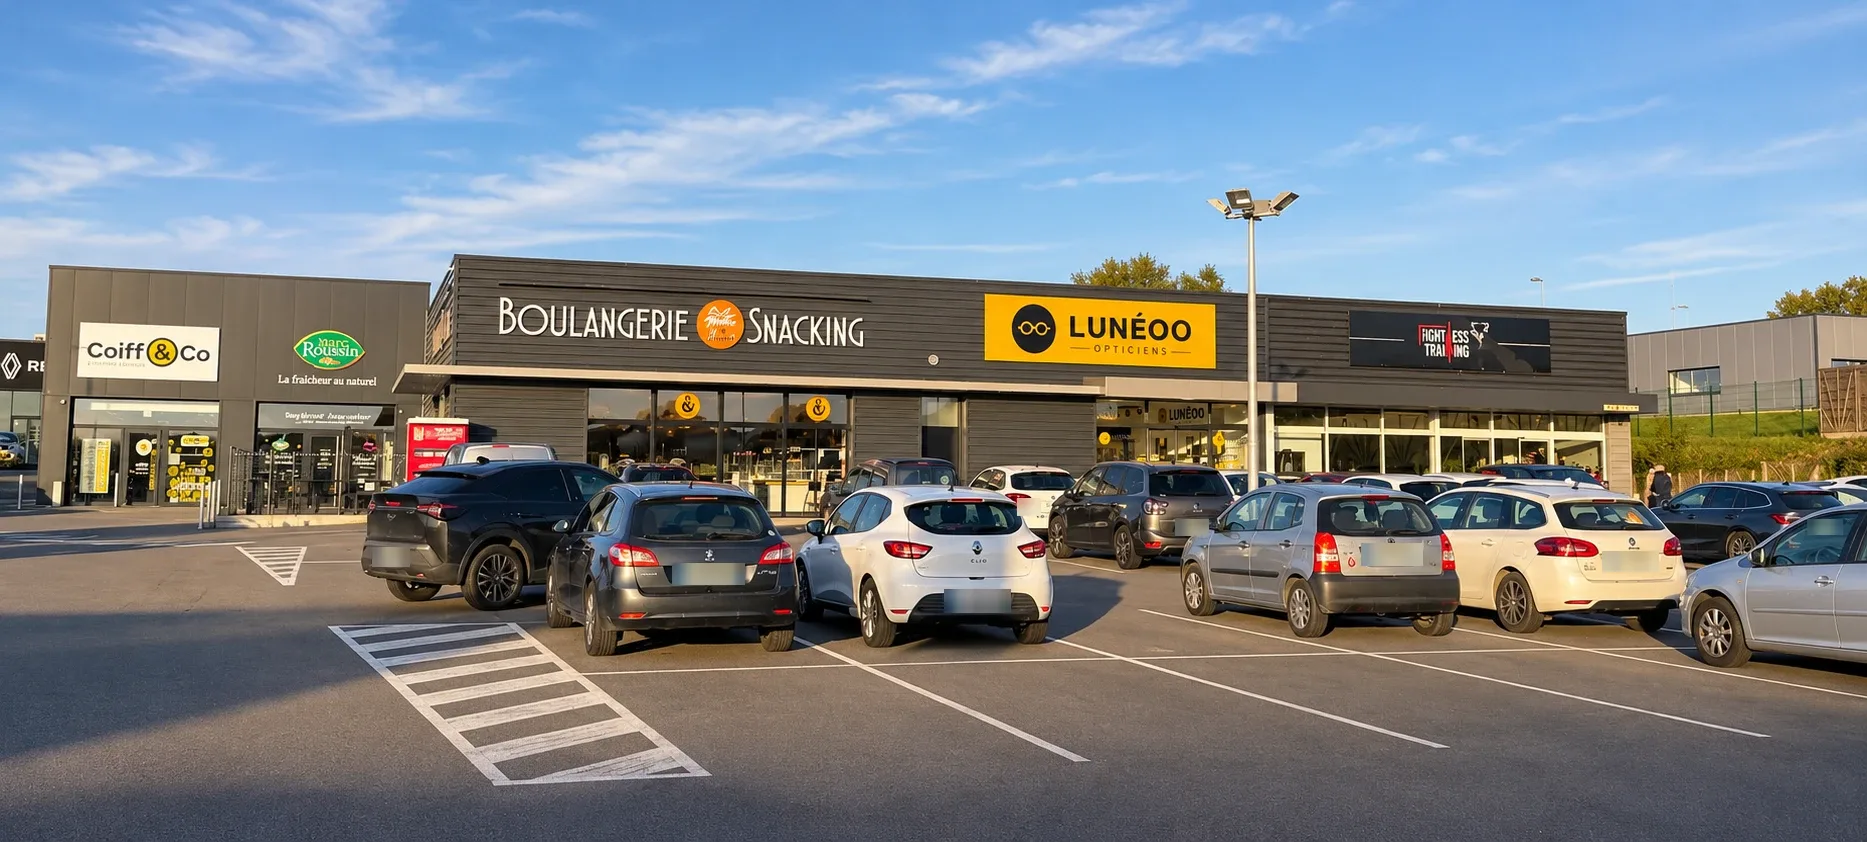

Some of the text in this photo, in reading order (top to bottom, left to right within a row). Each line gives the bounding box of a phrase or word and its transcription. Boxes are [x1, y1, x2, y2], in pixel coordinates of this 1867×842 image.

[498, 297, 864, 347] BOULANGERIE SNACKING
[1070, 312, 1192, 342] LUNÉOO
[87, 342, 145, 360] Coiff
[180, 345, 210, 362] Co
[302, 341, 359, 358] Roussin
[1094, 345, 1167, 356] OPTICIENS
[278, 374, 290, 384] La
[333, 378, 344, 386] au
[346, 377, 377, 386] naturel
